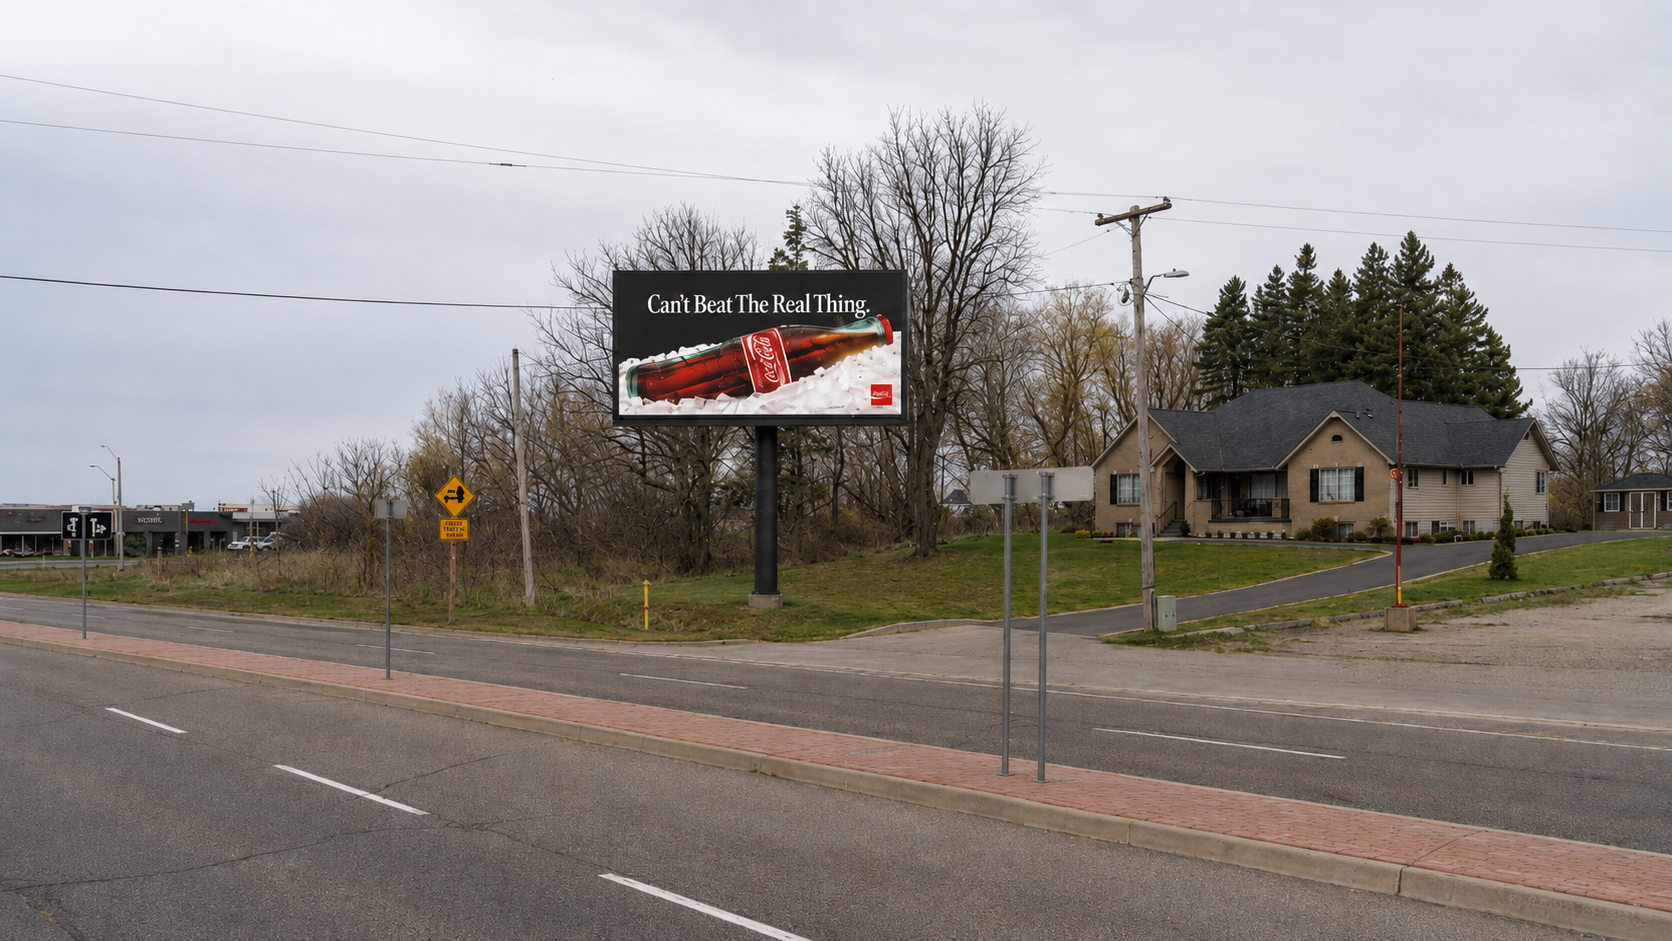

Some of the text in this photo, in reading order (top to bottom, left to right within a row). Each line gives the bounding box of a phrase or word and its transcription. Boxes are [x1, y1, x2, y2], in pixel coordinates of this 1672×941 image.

[647, 293, 870, 319] Can't Beat The Real Thing.
